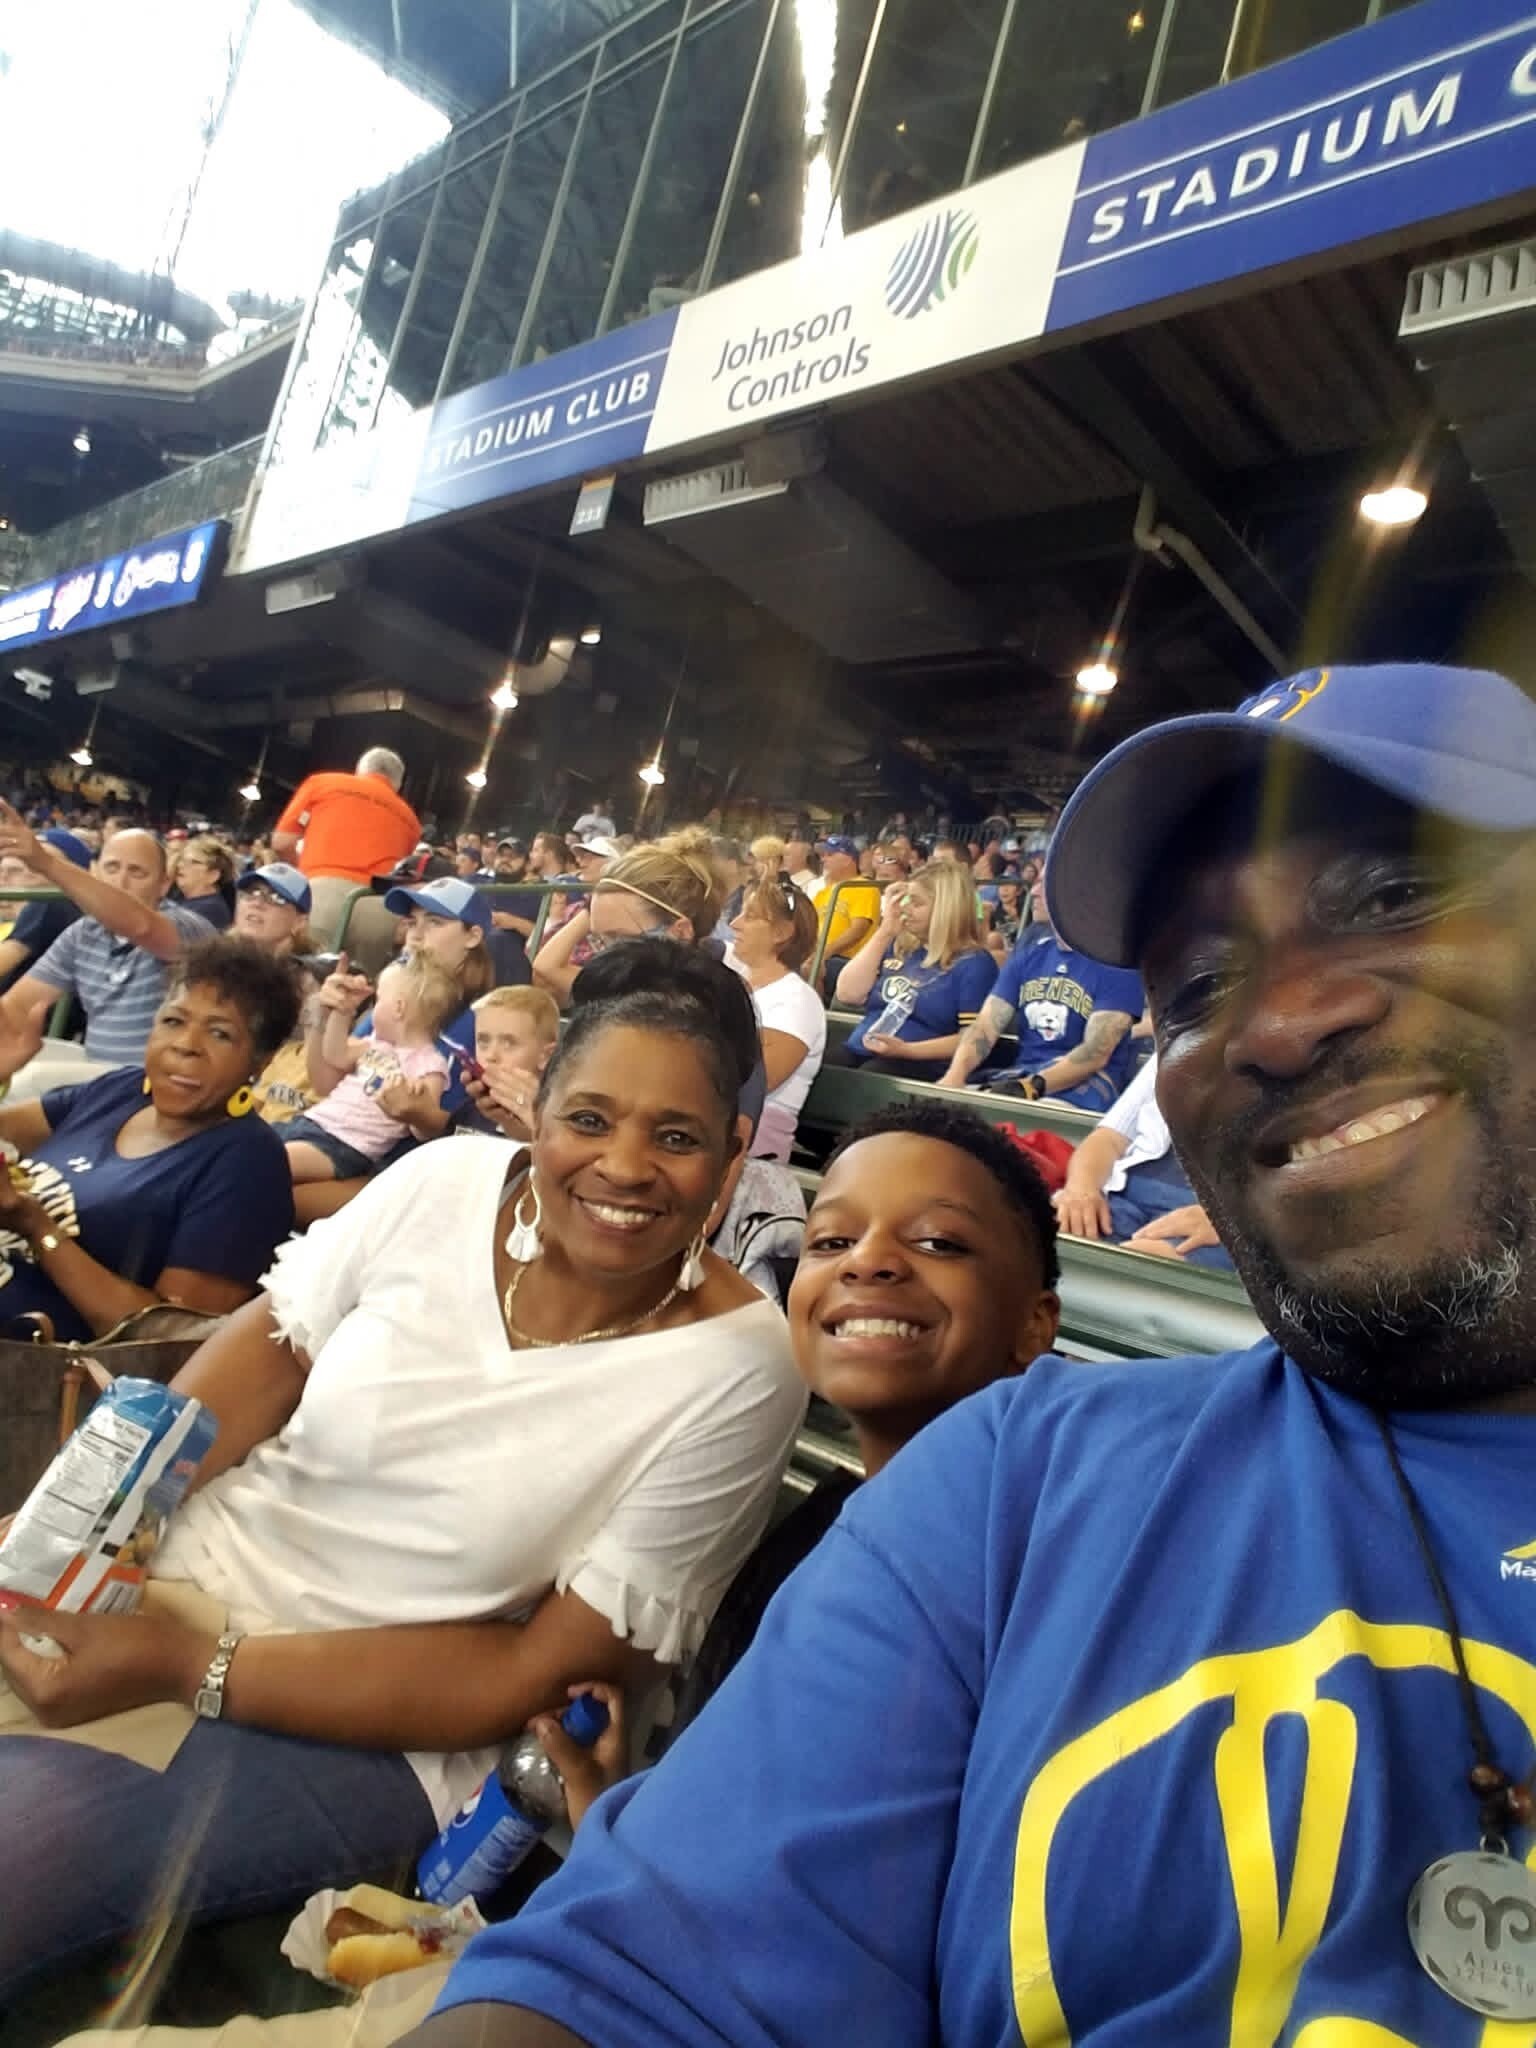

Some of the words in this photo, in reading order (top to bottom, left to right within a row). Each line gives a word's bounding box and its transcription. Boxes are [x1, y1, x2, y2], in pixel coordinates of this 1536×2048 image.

[1087, 72, 1463, 244] STADIUM
[711, 304, 852, 382] Johnson
[727, 336, 872, 412] Controls
[424, 404, 555, 475] STADIUM
[566, 371, 650, 425] CLUB
[1500, 1559, 1536, 1582] Ma
